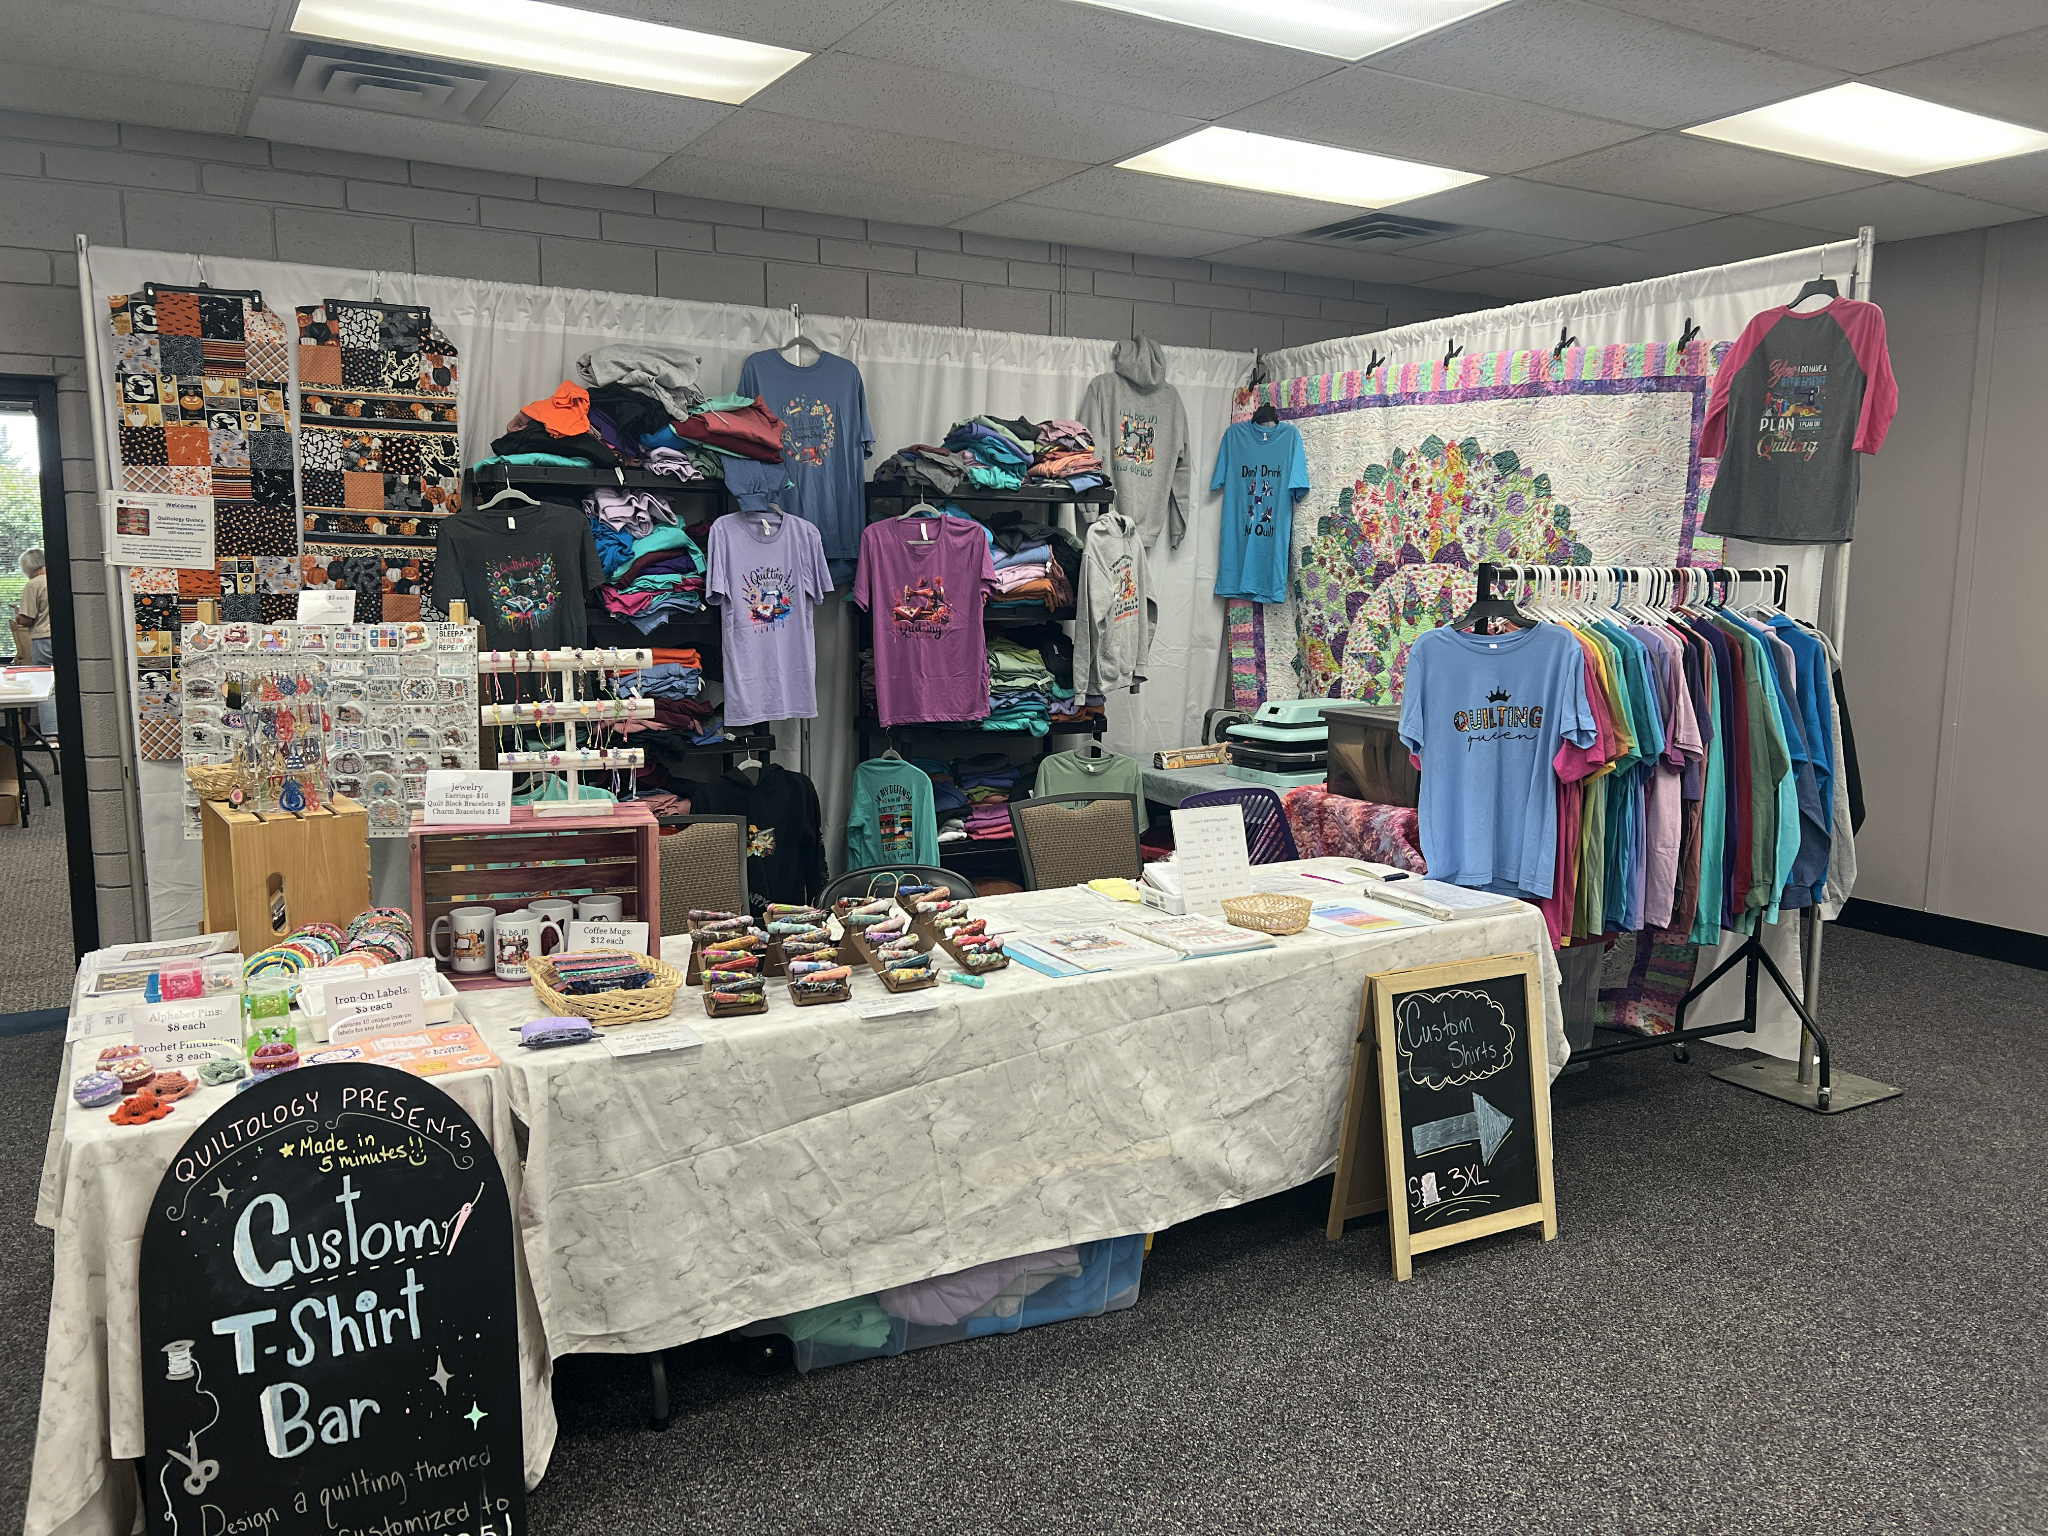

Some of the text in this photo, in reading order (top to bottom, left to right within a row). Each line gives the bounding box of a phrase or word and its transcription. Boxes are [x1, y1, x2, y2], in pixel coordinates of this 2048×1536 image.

[1760, 417, 1794, 432] PLAN
[750, 567, 784, 588] Quilting
[1453, 706, 1544, 732] QUILTING
[1466, 730, 1538, 752] queen
[583, 926, 632, 937] Coffee Mugs:
[590, 936, 624, 945] $12 each
[334, 991, 374, 1005] Iron-On
[167, 1021, 206, 1033] $8 each
[1406, 1000, 1474, 1049] Custom
[141, 1042, 177, 1054] rochet
[187, 1050, 212, 1061] each
[1448, 1040, 1497, 1070] Shirts
[176, 1087, 472, 1183] QUILTOLOGY PRESENTS
[300, 1133, 375, 1157] Made in
[319, 1155, 333, 1172] 5
[233, 1174, 444, 1288] Custom
[211, 1268, 424, 1375] T-Shirt
[259, 1381, 381, 1459] Bar
[200, 1502, 280, 1536] Design
[294, 1490, 308, 1514] a
[339, 1501, 469, 1536] stomized
[481, 1495, 510, 1516] to
